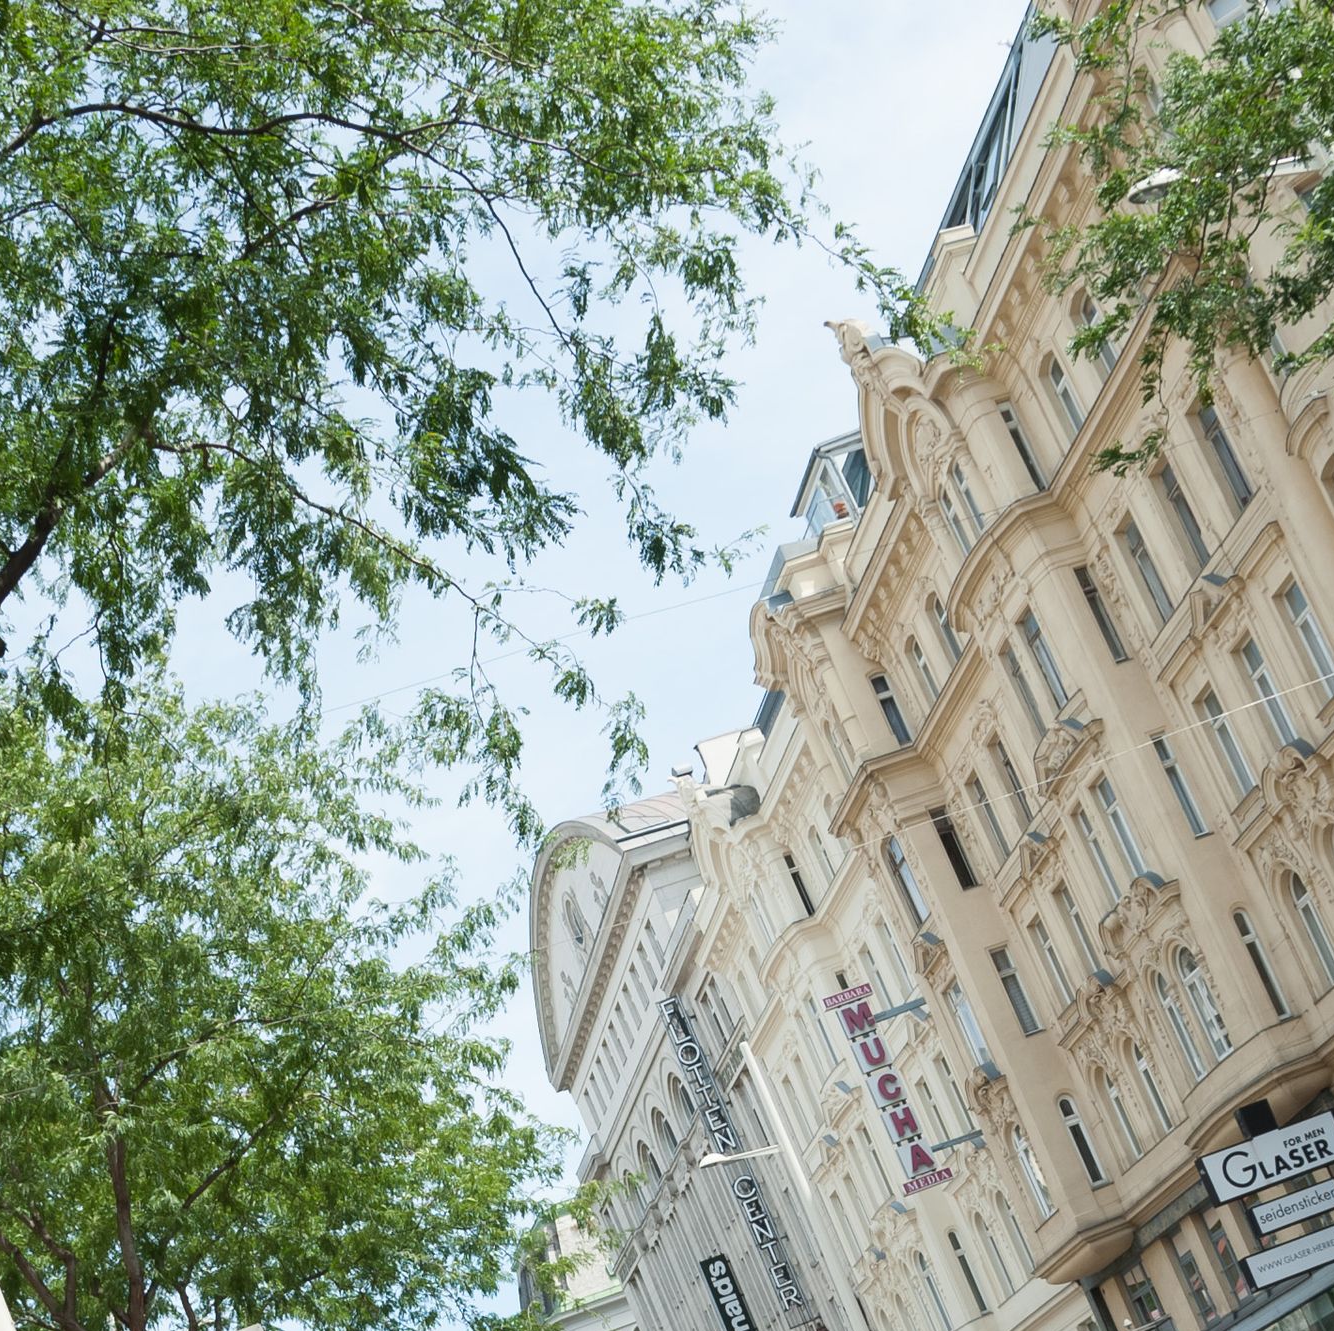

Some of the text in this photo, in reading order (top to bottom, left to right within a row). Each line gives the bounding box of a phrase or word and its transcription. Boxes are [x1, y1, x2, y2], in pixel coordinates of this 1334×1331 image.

[824, 984, 871, 1008] BARBARA
[841, 1001, 936, 1173] MUCHA
[659, 997, 737, 1154] FLOTTEN
[732, 1174, 803, 1313] CENTER
[1282, 1127, 1326, 1149] FOR MEN
[906, 1169, 951, 1193] MEDIA
[1222, 1138, 1334, 1189] GLASER
